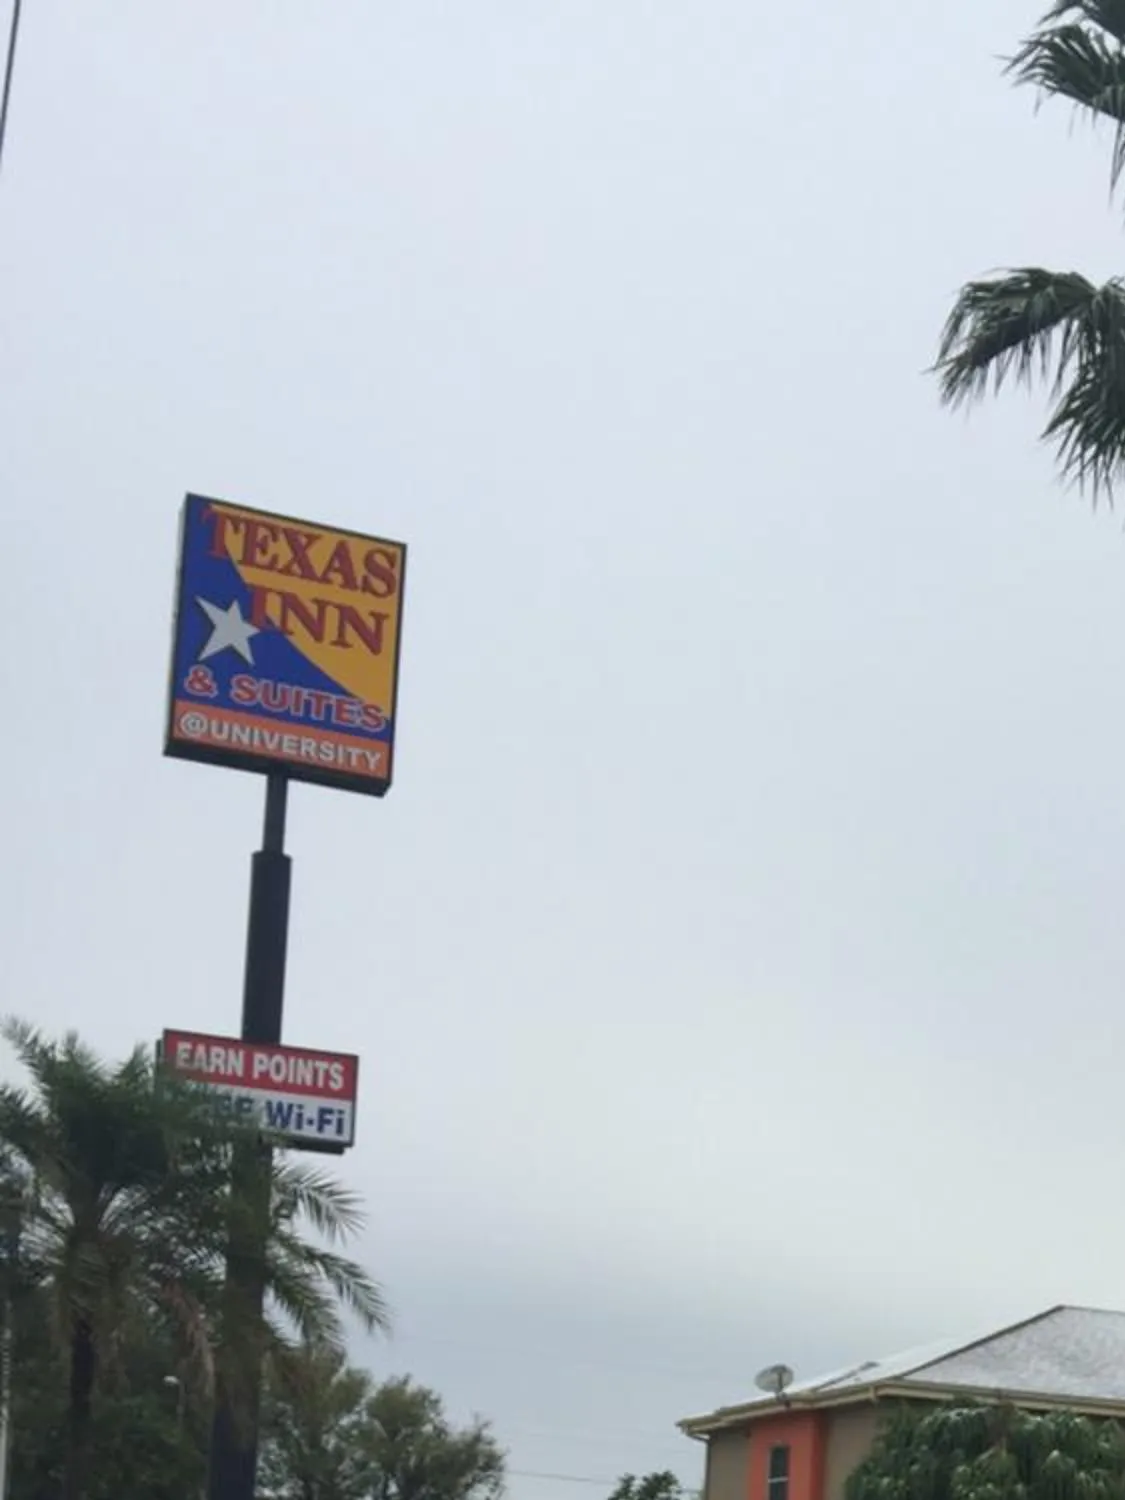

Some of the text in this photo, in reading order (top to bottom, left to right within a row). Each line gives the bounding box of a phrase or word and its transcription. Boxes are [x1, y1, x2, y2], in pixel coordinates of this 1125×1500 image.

[204, 505, 397, 599] TEXAS
[245, 582, 389, 656] INN
[184, 664, 386, 733] & SUITES
[179, 711, 382, 771] @UNIVERSITY
[175, 1041, 345, 1091] EARN POINTS
[266, 1099, 345, 1136] Wi-Fi
